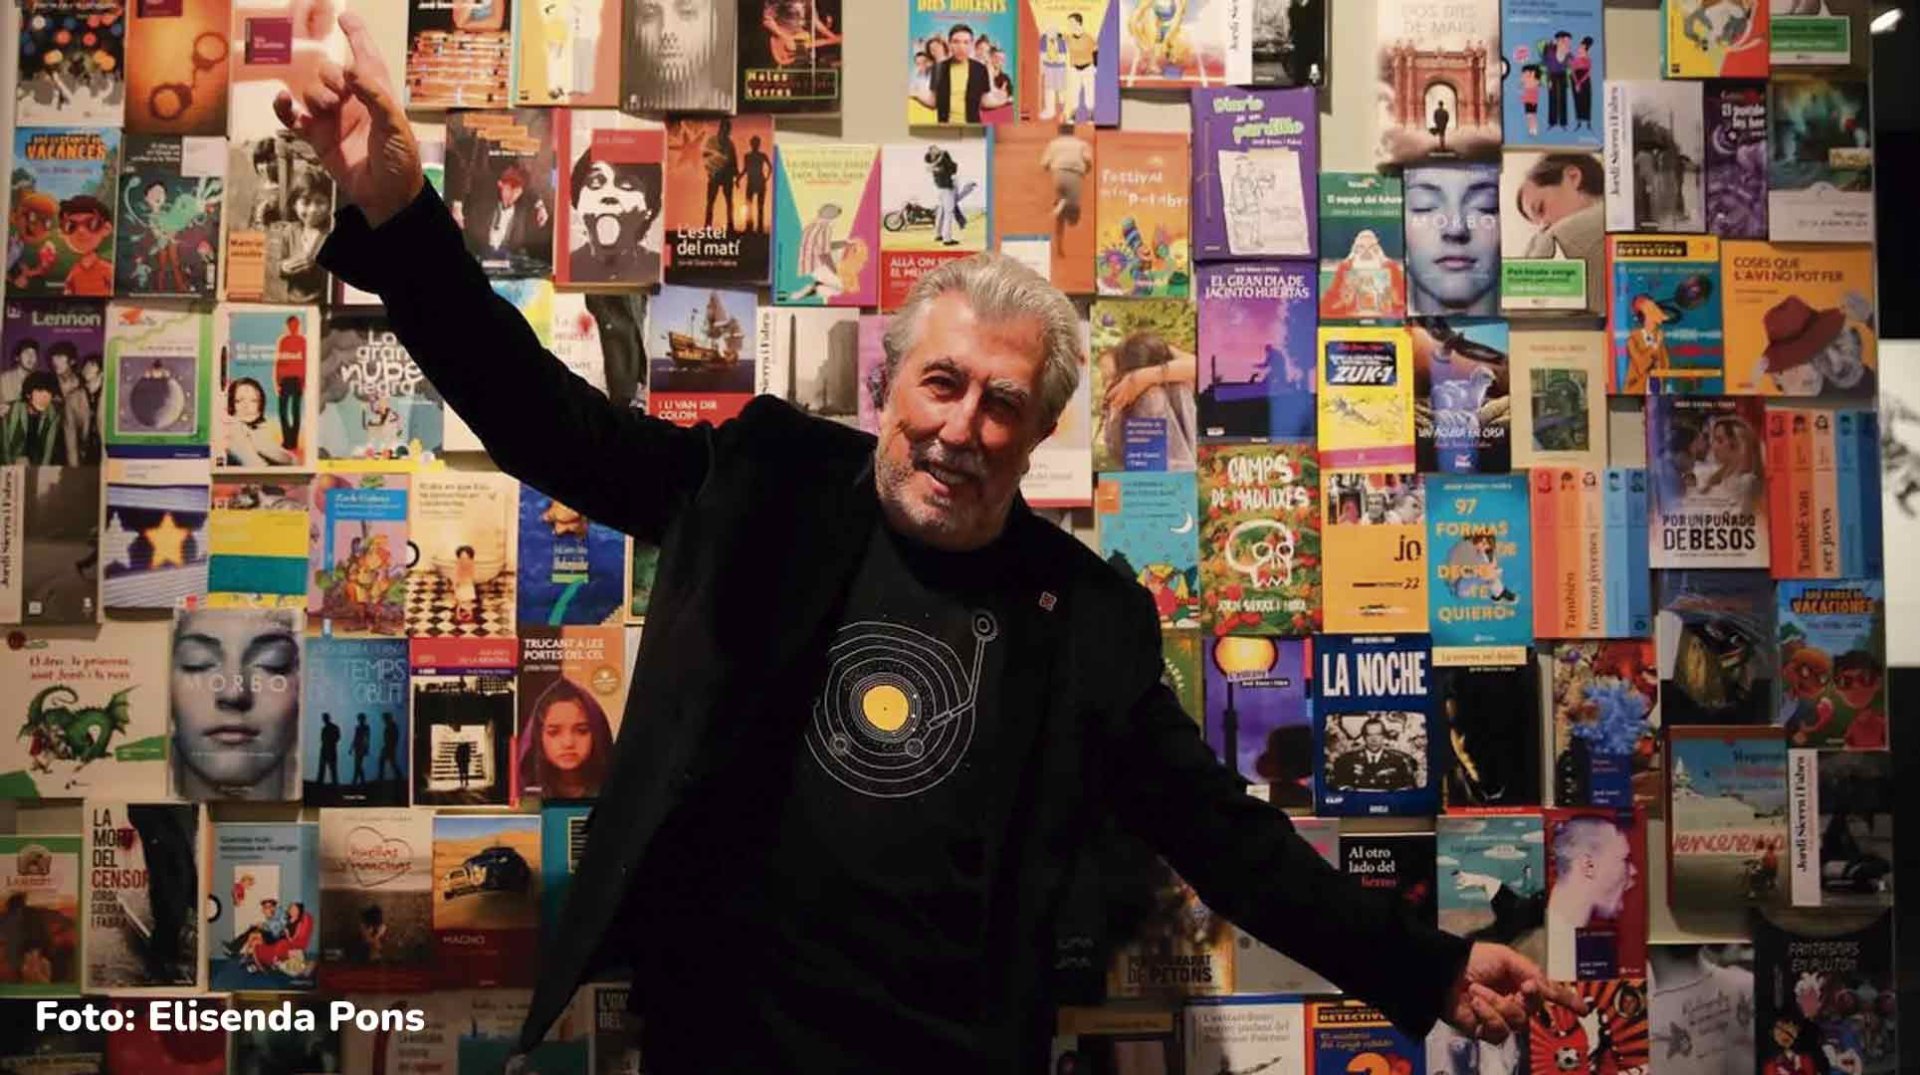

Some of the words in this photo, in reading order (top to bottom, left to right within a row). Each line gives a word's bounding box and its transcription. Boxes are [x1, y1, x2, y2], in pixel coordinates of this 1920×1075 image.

[676, 225, 727, 239] L'estel
[676, 240, 701, 256] del
[703, 240, 741, 256] matí
[1734, 256, 1771, 268] COSES
[1774, 256, 1800, 268] QUE
[1211, 275, 1226, 287] EL
[1227, 276, 1263, 287] GRAN
[1287, 276, 1304, 287] DE
[1205, 287, 1253, 299] JACINTO
[1254, 287, 1310, 299] HUERTAS
[32, 311, 102, 326] Lennon
[368, 330, 397, 346] La
[340, 362, 425, 384] nube
[1333, 364, 1393, 385] ZUK-1
[350, 379, 415, 399] negra
[1227, 454, 1293, 484] CAMPS
[1211, 488, 1226, 508] DE
[1229, 486, 1312, 510] MADUIXES
[1455, 498, 1479, 515] 97
[1663, 513, 1687, 527] POR
[1688, 514, 1704, 527] UN
[1704, 510, 1756, 527] PUÑADO
[1435, 520, 1509, 537] FORMAS
[1663, 529, 1686, 551] DE
[1689, 529, 1756, 551] BESOS
[1822, 546, 1834, 572] ser
[1564, 572, 1577, 630] También
[524, 638, 573, 649] TRUCANT
[523, 649, 562, 660] PORTES
[345, 658, 408, 682] TEMPS
[1322, 653, 1350, 697] LA
[1358, 652, 1428, 697] NOCHE
[187, 675, 288, 692] MORBO
[1794, 756, 1806, 791] Fabra
[93, 809, 112, 827] LA
[1796, 800, 1807, 837] Sierra
[93, 849, 118, 867] DEL
[1348, 847, 1364, 859] Al
[1366, 848, 1391, 858] otro
[1797, 839, 1808, 872] Jordi
[1348, 861, 1376, 874] lado
[1378, 861, 1396, 874] del
